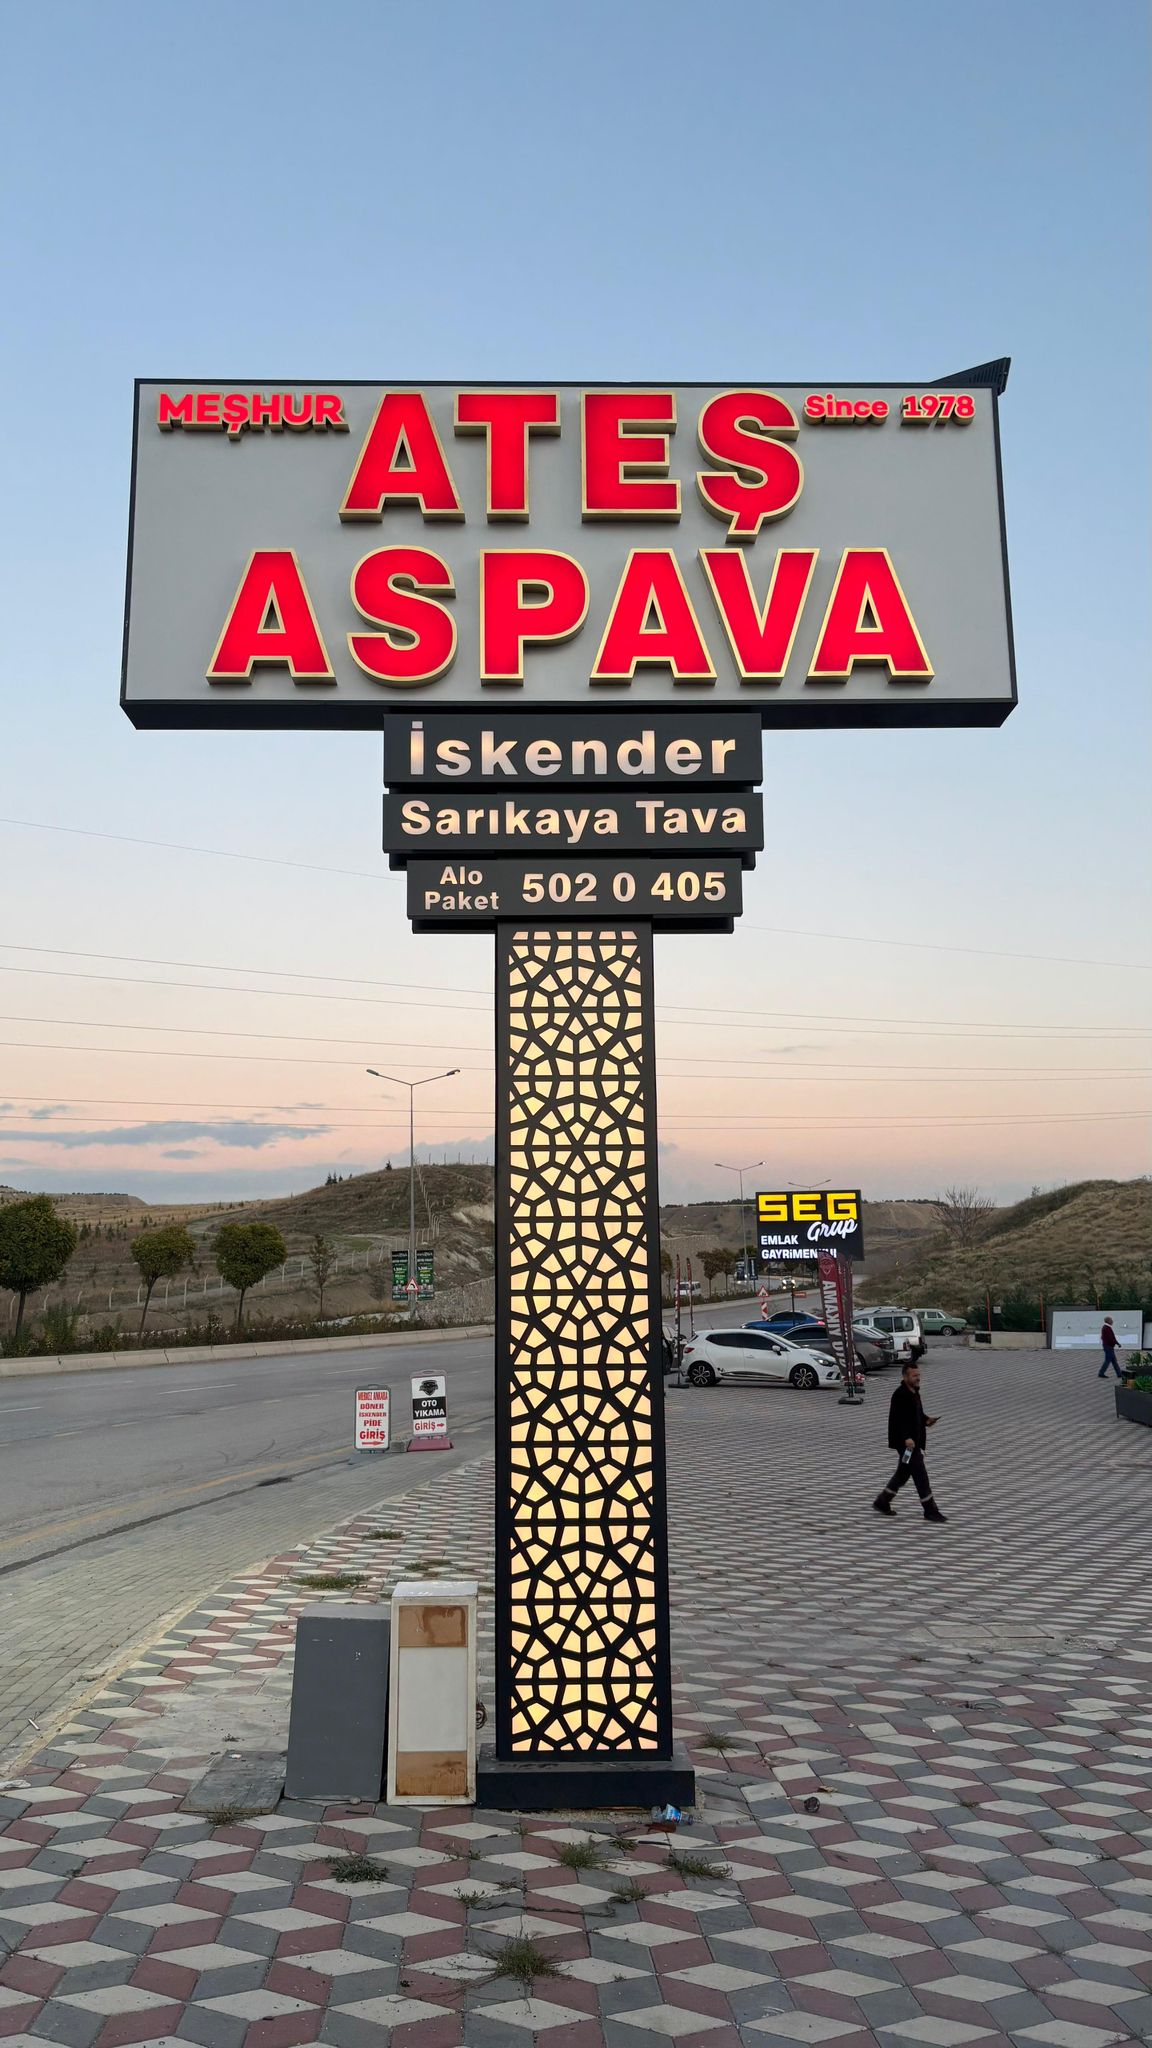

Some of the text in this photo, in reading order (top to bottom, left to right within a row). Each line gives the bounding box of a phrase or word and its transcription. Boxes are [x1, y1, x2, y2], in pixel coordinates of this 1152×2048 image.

[157, 392, 346, 434] MEŞHUR
[803, 392, 976, 421] Since 1978
[339, 389, 804, 539] ATEŞ
[206, 545, 935, 684] ASPAVA
[410, 721, 736, 776] İskender
[401, 800, 747, 844] Sarıkaya Tava
[439, 866, 484, 885] Alo
[522, 871, 727, 903] 502 0 405
[424, 891, 500, 911] Paket
[758, 1193, 857, 1221] SEG
[760, 1235, 799, 1245] EMLAK
[807, 1219, 858, 1241] Grup
[363, 1418, 382, 1426] PİDE
[414, 1408, 445, 1417] YIKAMA
[360, 1428, 385, 1440] GİRİŞ
[414, 1421, 436, 1431] GİRİŞ
